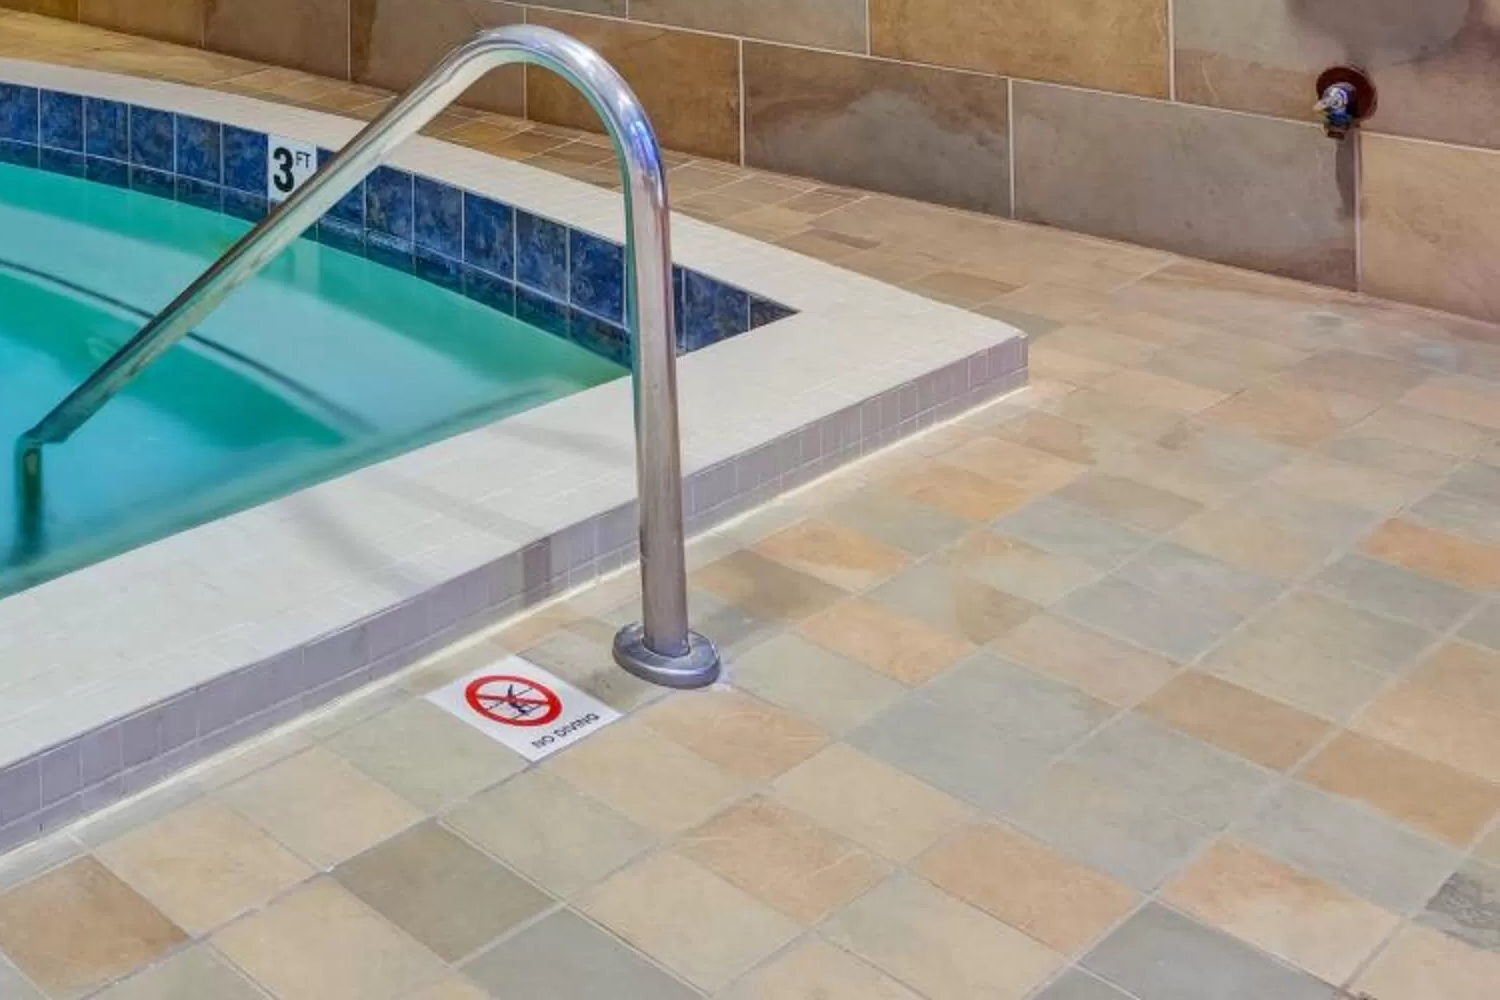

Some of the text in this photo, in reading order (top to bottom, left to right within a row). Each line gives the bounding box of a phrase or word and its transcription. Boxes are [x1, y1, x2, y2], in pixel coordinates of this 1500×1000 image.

[273, 147, 311, 192] 3 FT
[531, 712, 600, 749] NO DIVING
